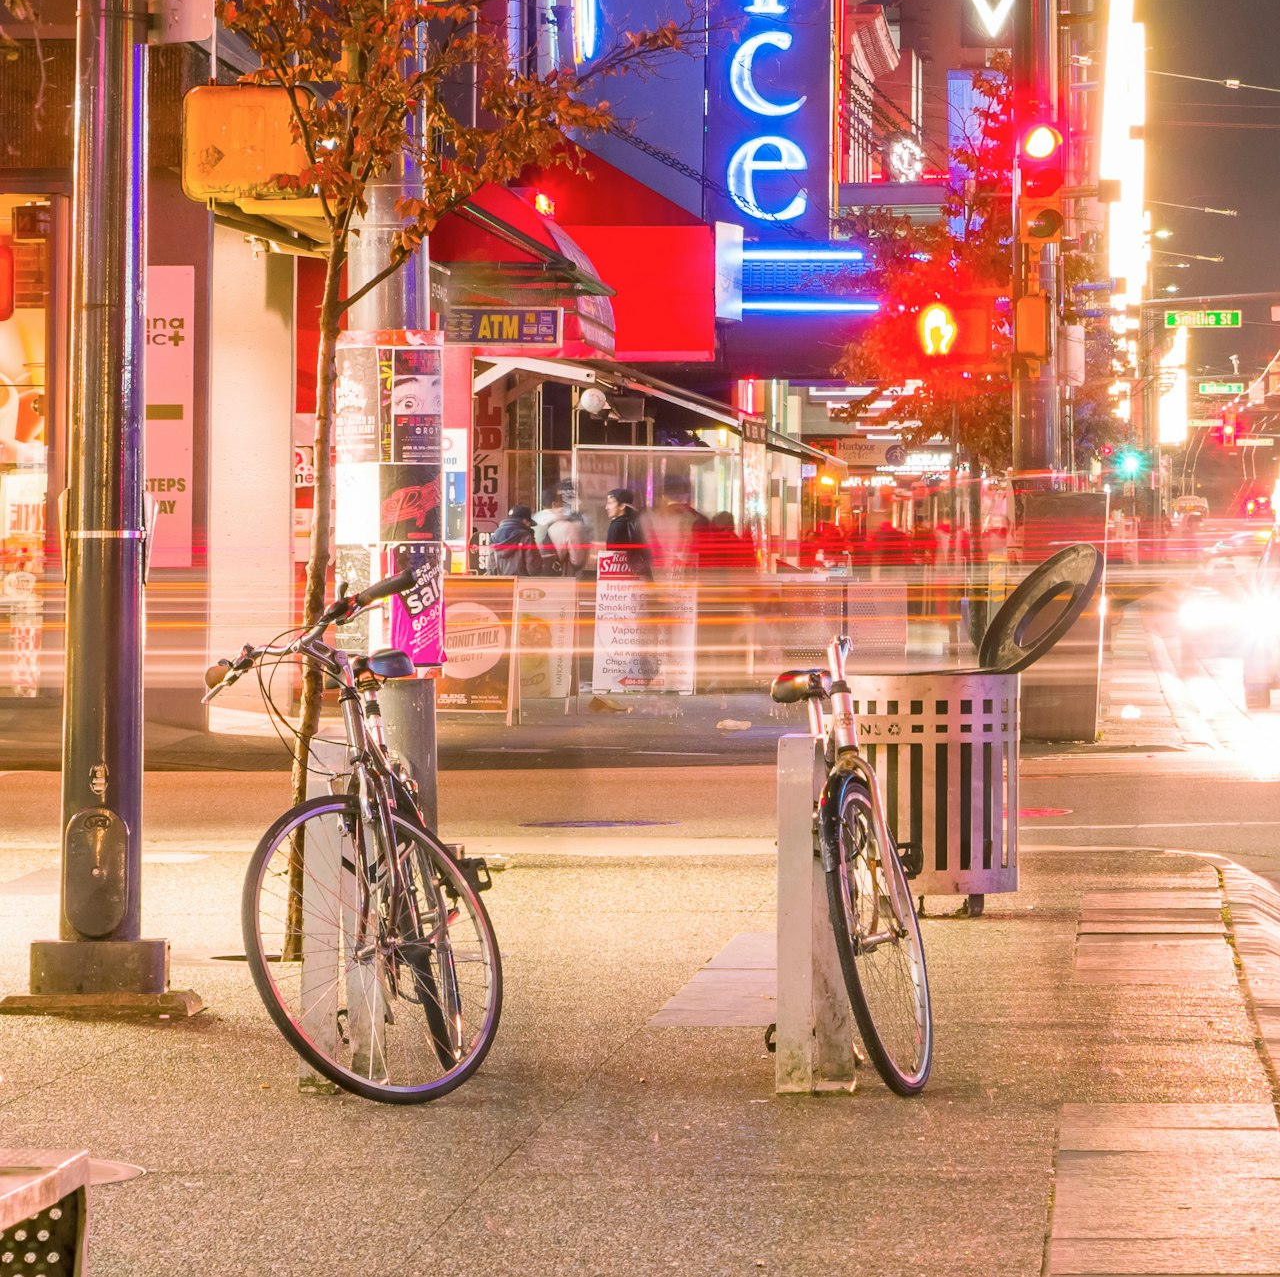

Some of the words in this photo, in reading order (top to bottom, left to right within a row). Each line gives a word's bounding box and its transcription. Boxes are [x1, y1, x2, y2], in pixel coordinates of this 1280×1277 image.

[1220, 313, 1232, 325] St
[477, 314, 520, 340] ATM
[838, 442, 876, 452] Harbour
[600, 594, 628, 602] Water
[598, 604, 636, 614] Smoking
[446, 633, 476, 650] CONUT
[477, 630, 499, 646] MILK
[461, 654, 475, 662] GOT
[605, 658, 627, 666] Chips
